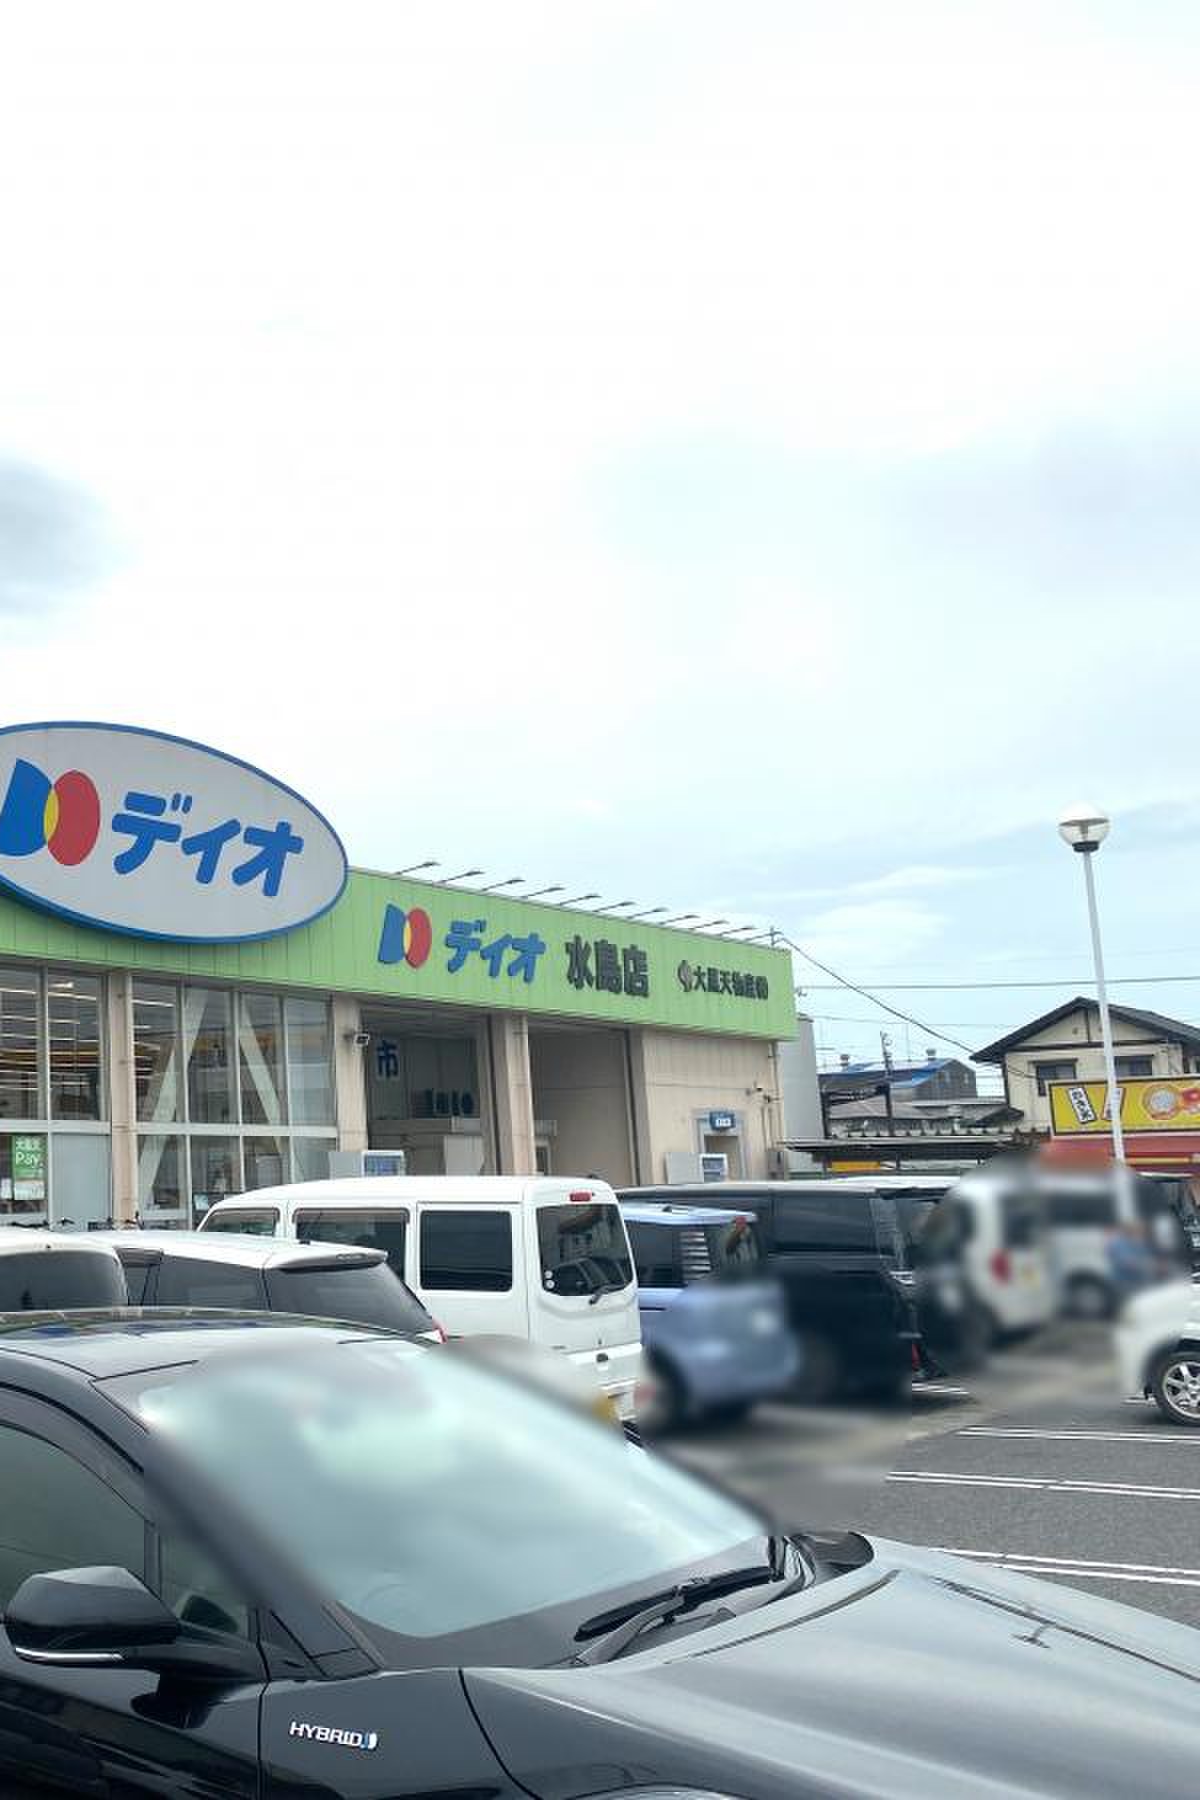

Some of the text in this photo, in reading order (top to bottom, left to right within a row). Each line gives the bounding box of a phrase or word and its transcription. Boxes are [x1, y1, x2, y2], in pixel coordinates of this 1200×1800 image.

[111, 791, 304, 897] ディオ
[444, 919, 650, 998] ディオ 水島店
[15, 1151, 41, 1169] Pay
[289, 1721, 363, 1747] HYBRID
